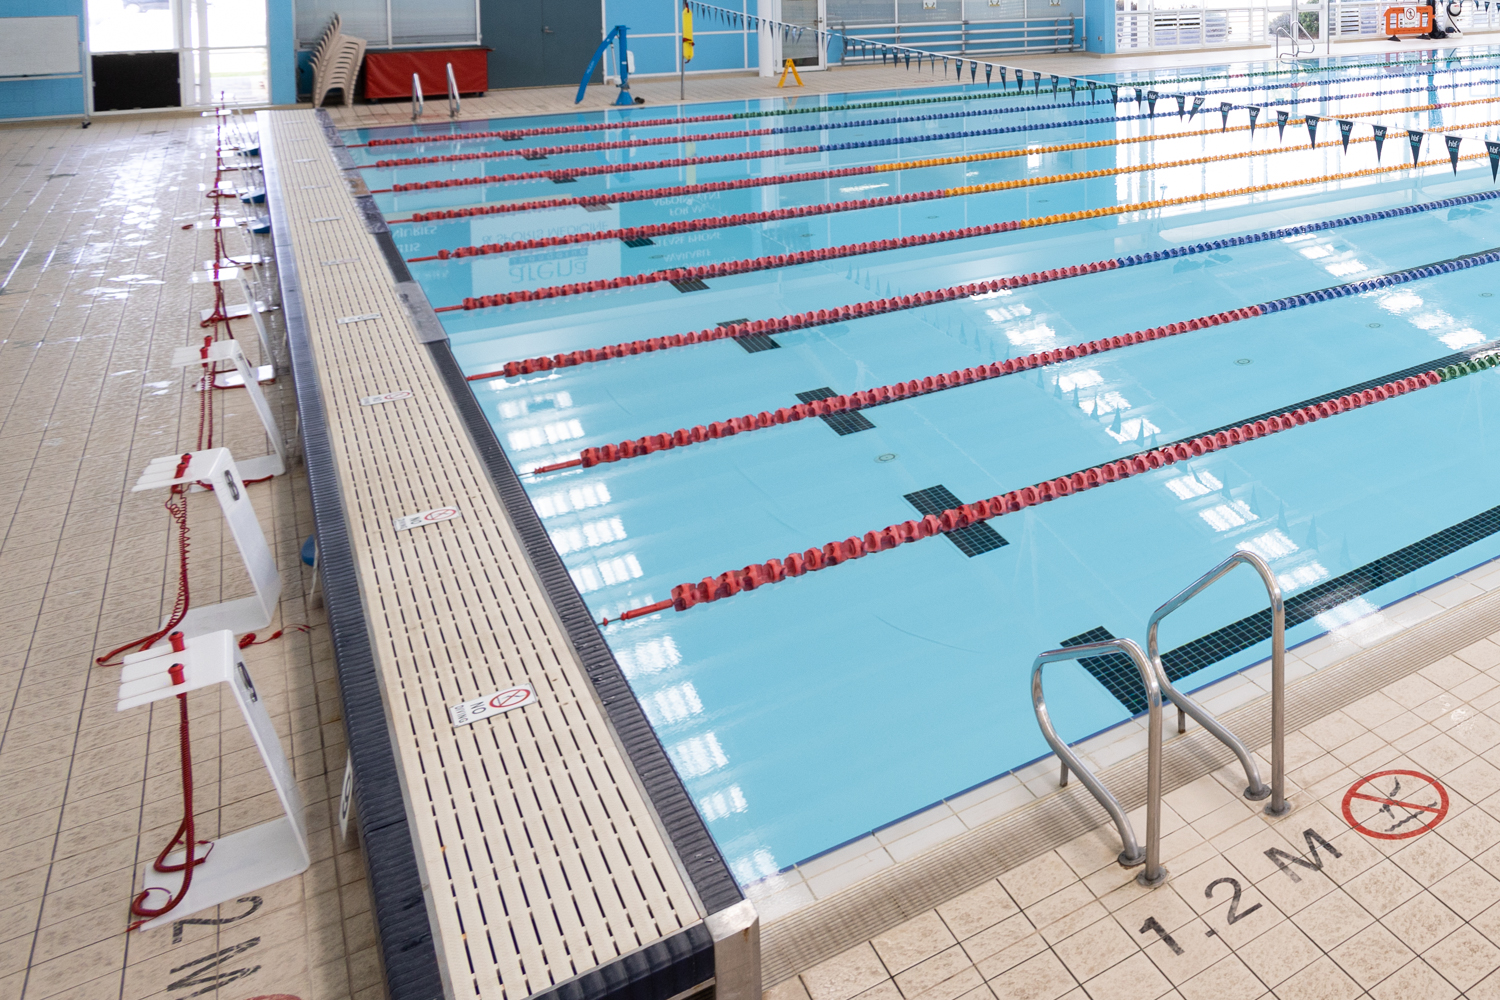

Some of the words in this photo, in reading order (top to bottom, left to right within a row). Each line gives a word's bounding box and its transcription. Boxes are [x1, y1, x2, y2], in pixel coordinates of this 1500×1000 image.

[1410, 134, 1420, 142] hbf
[1489, 146, 1499, 154] hbf
[470, 701, 487, 715] NO
